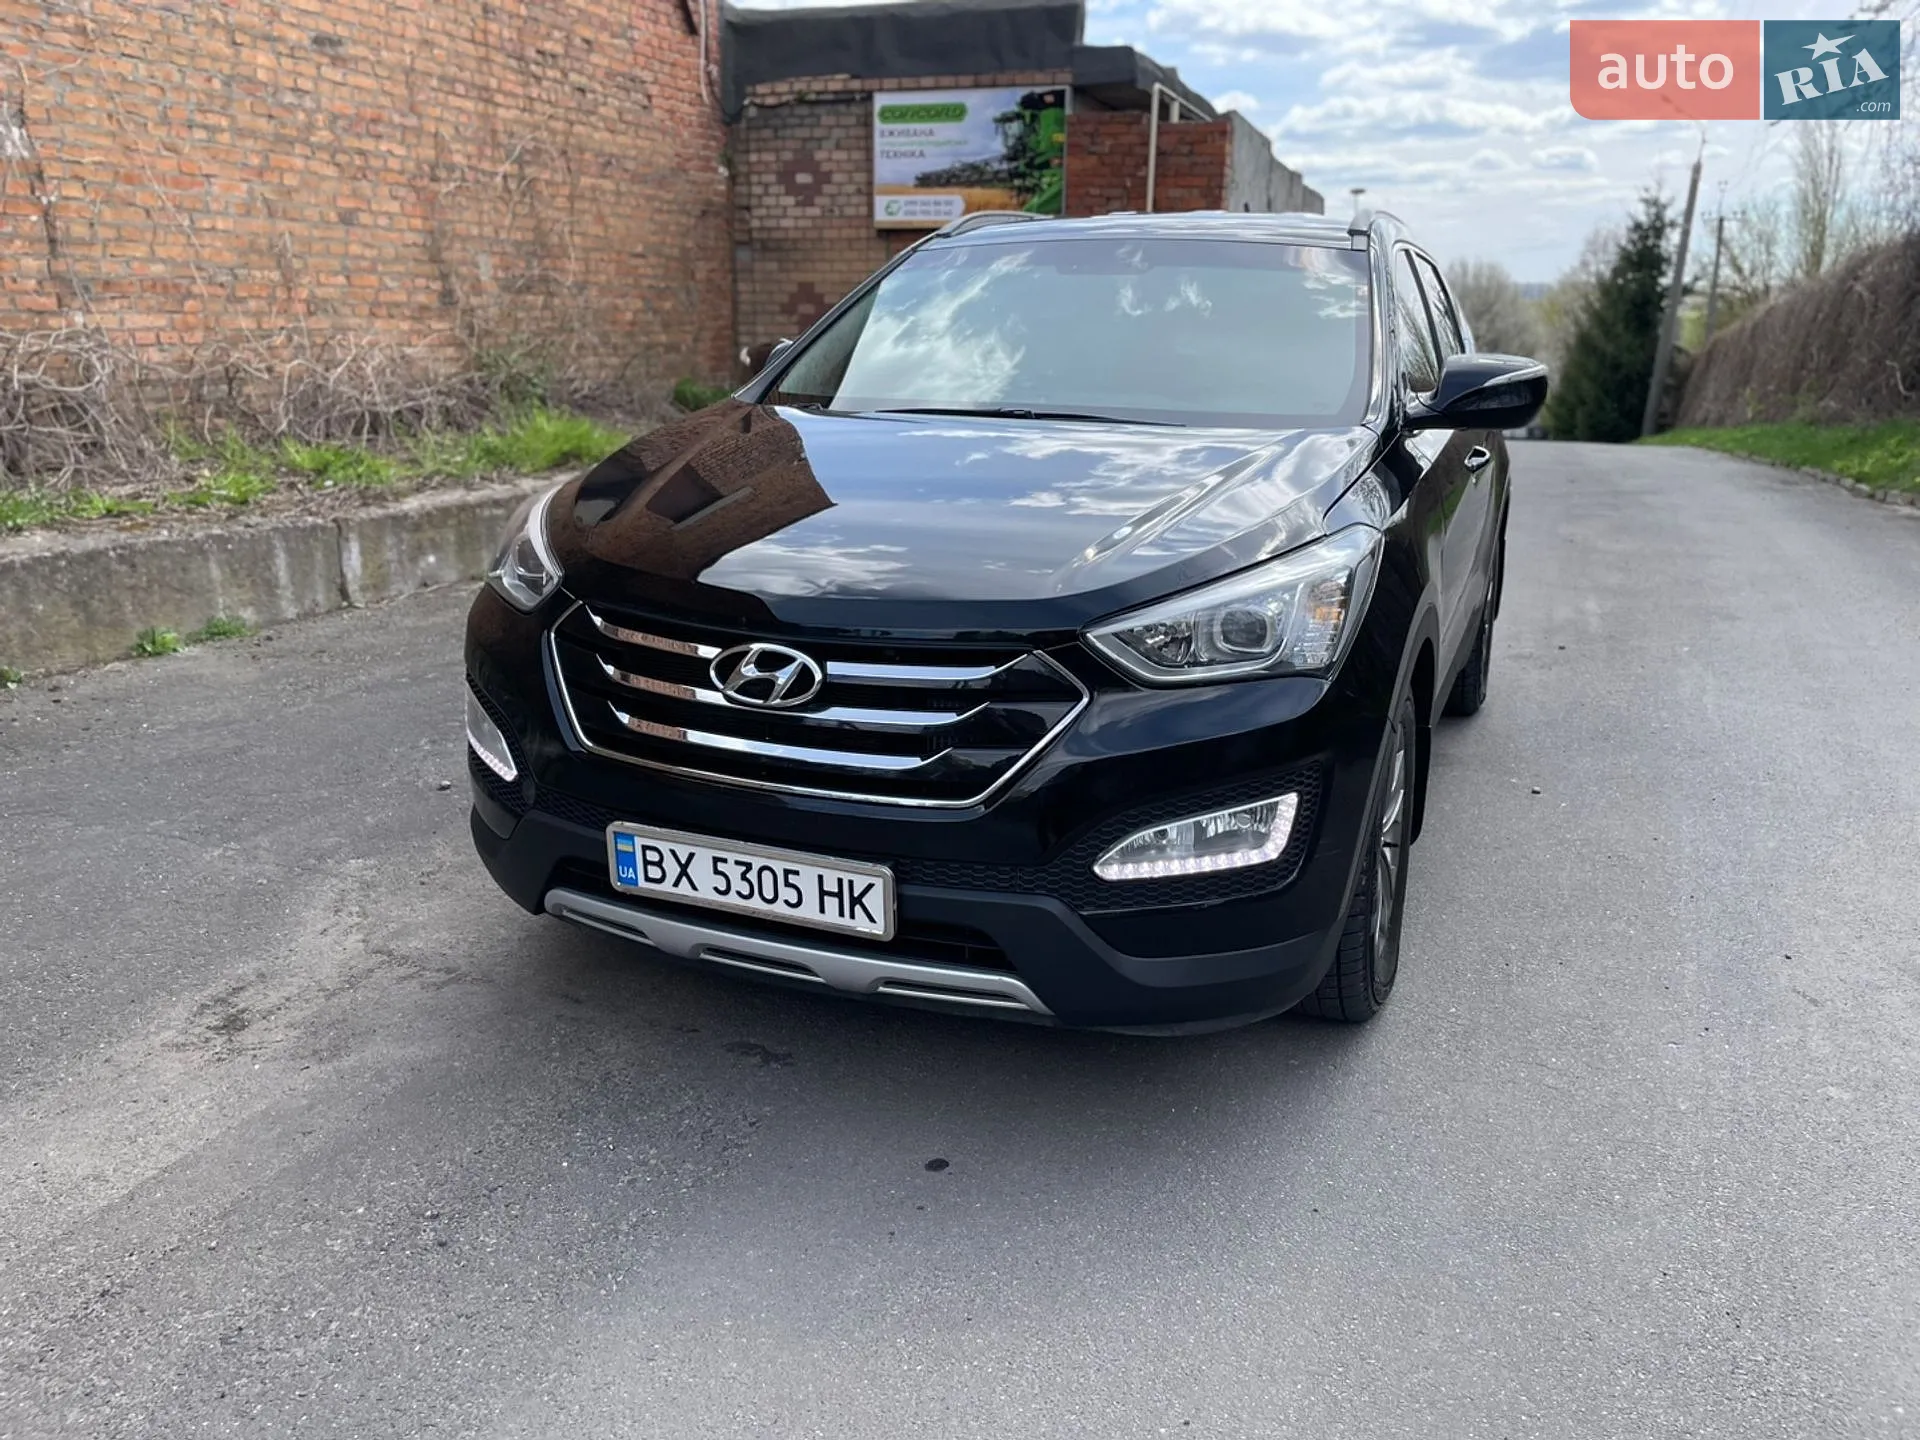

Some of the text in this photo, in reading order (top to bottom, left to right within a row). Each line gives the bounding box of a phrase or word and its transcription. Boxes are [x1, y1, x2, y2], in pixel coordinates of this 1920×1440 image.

[618, 865, 636, 881] UA
[640, 844, 877, 925] BX 5305 HK
